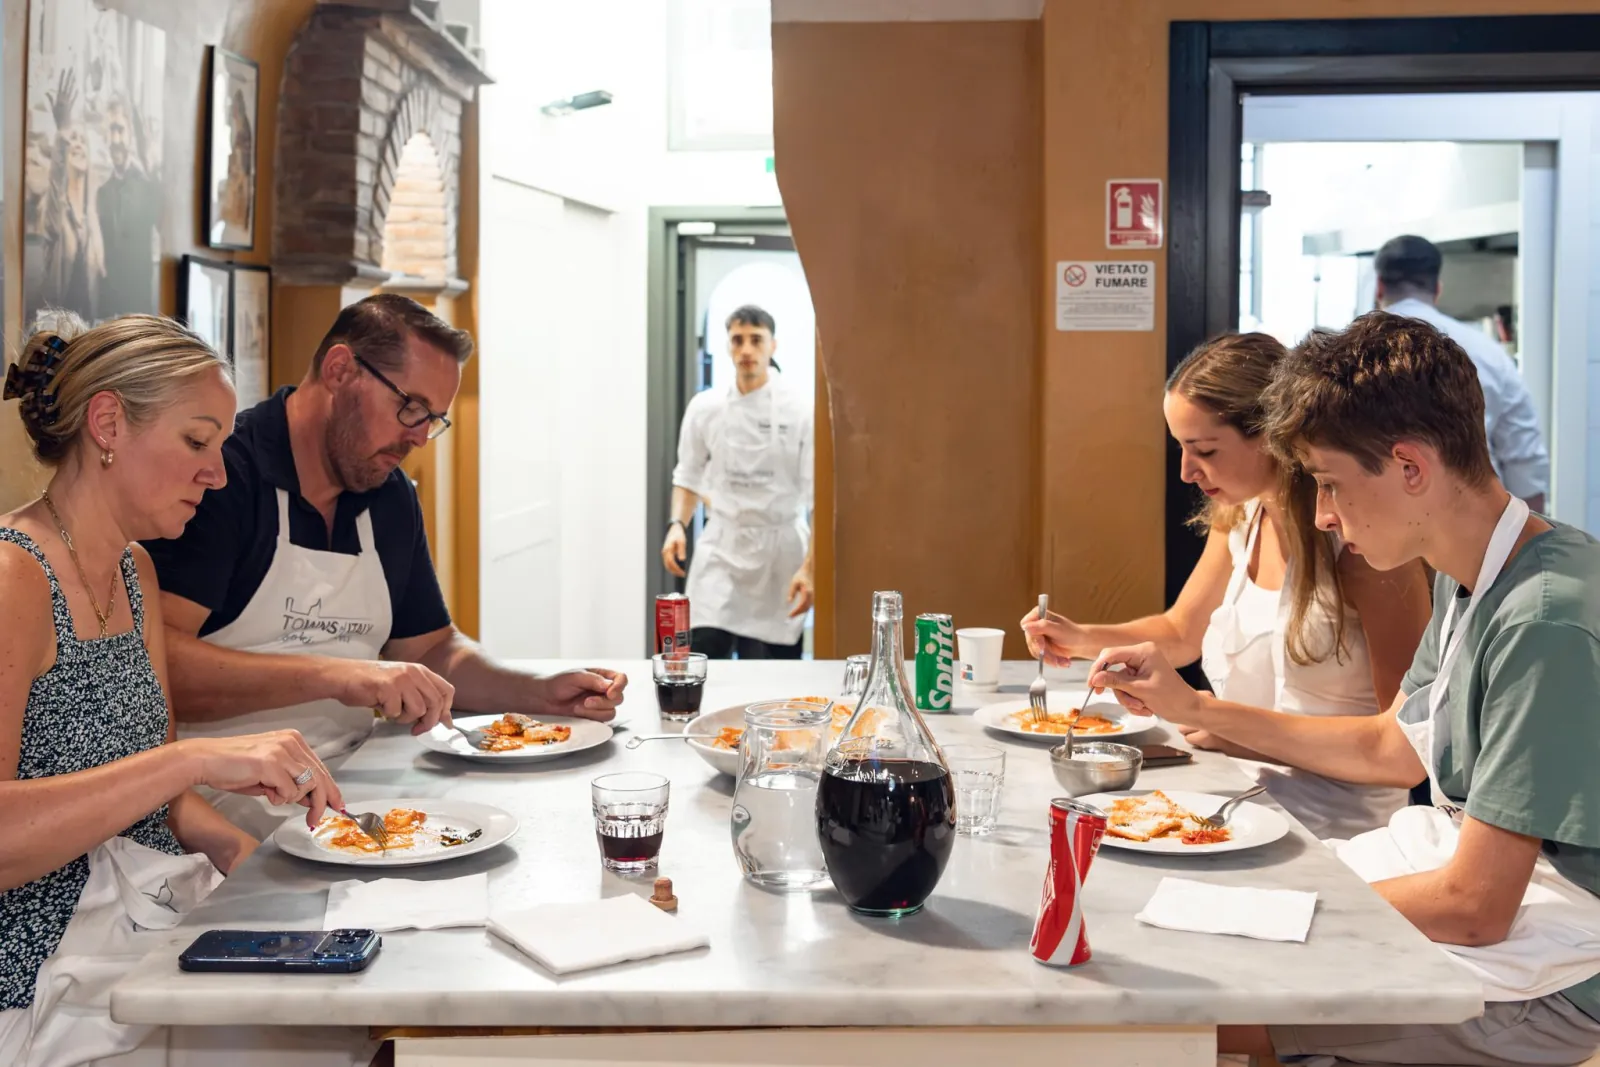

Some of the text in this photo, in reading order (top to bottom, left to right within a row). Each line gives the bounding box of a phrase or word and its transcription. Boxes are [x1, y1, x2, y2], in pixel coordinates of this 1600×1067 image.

[1095, 264, 1149, 275] VIETATO
[1095, 278, 1148, 288] FUMARE
[283, 614, 339, 635] TOWNS
[928, 618, 953, 708] Sprite
